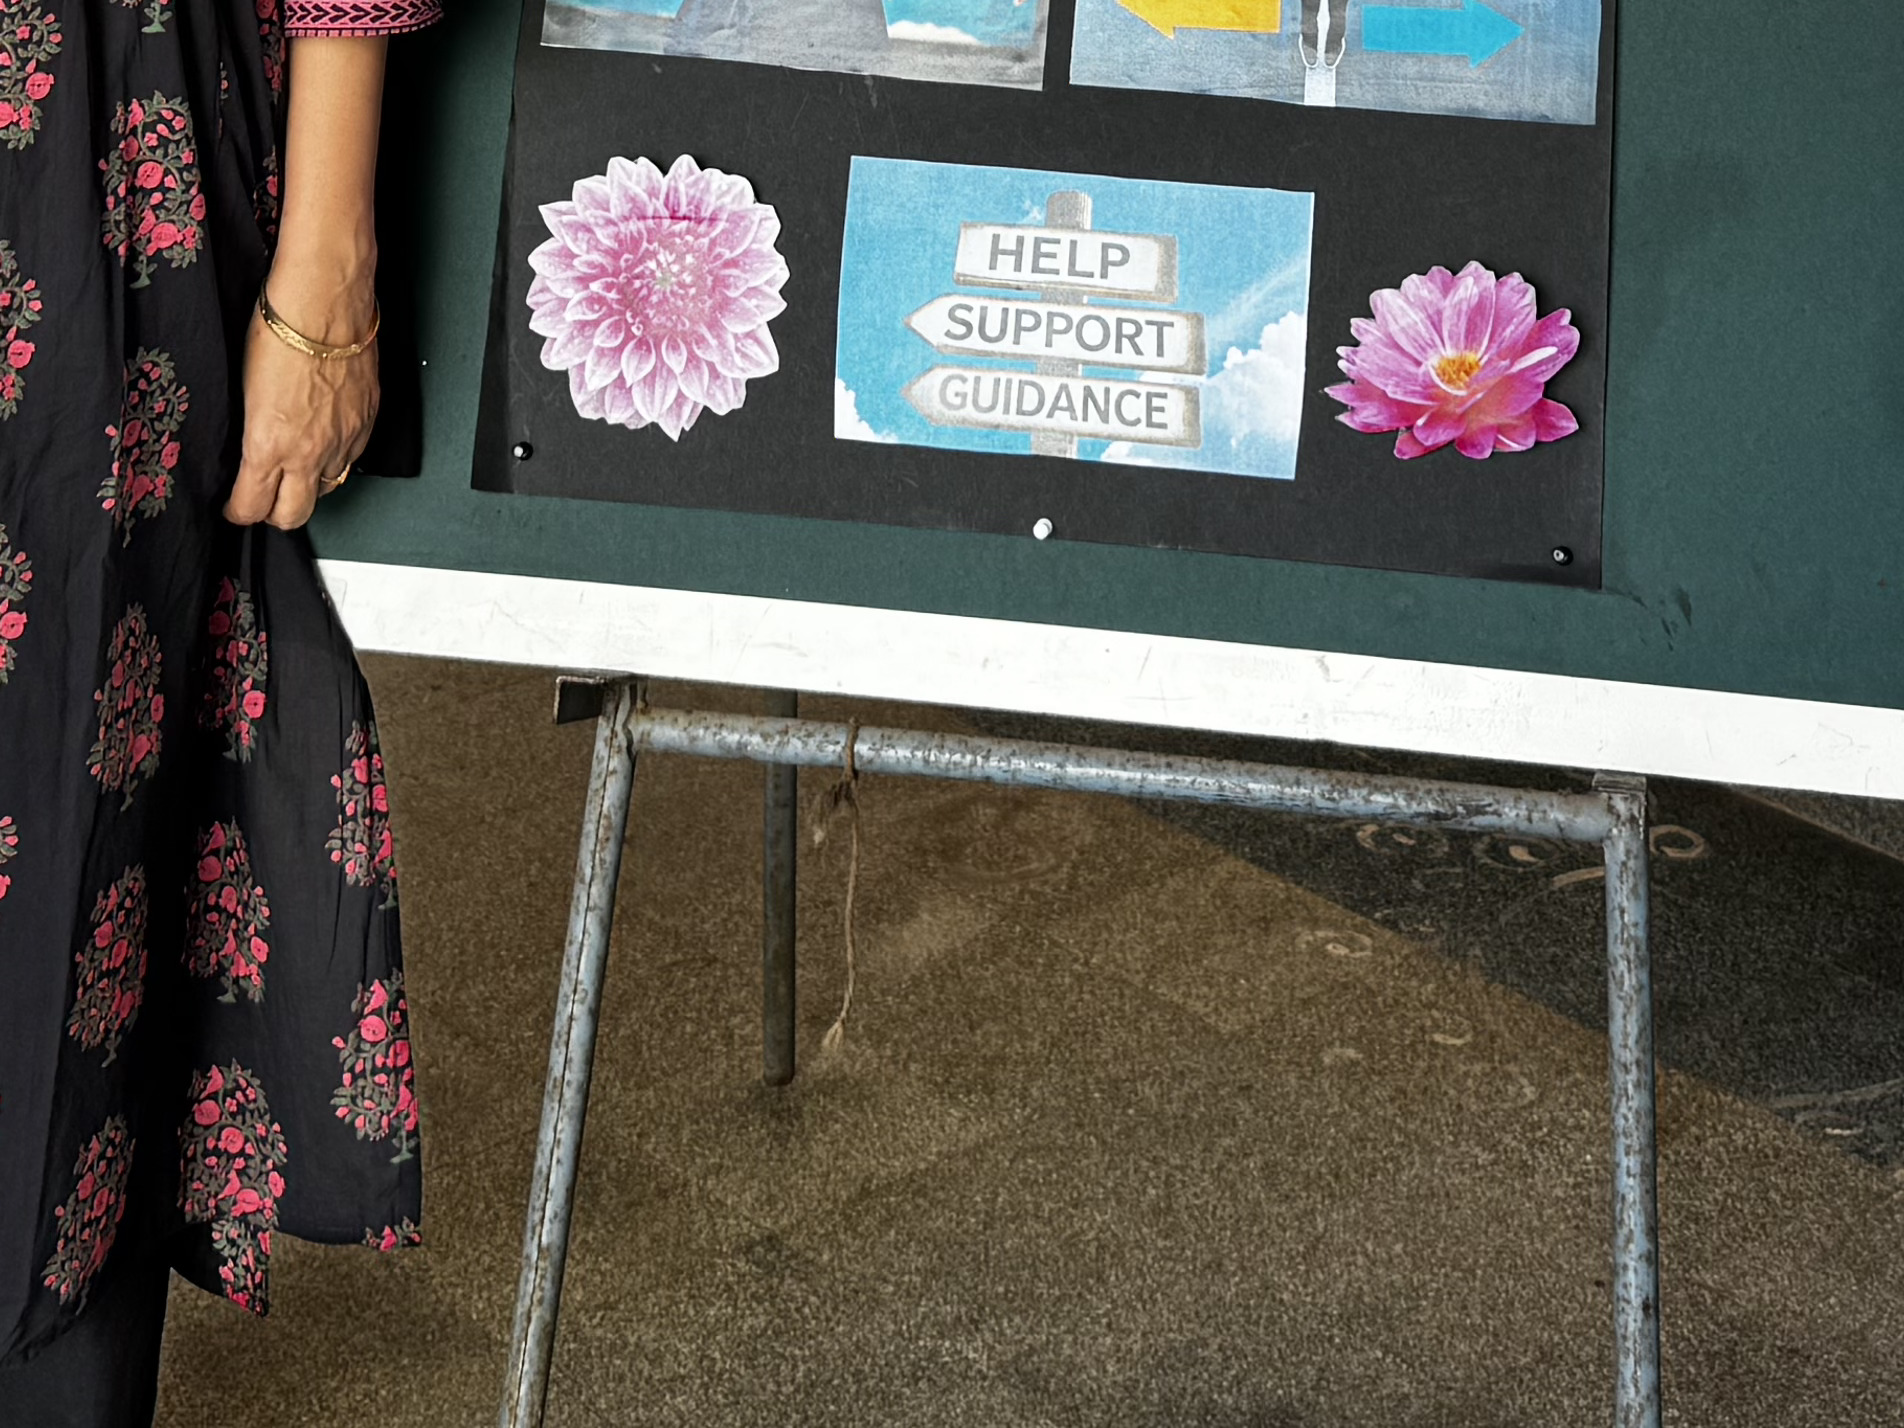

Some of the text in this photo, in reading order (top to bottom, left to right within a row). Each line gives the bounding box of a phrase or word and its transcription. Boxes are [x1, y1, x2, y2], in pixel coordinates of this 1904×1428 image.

[988, 232, 1131, 280] HELP
[943, 302, 1175, 358] SUPPORT
[938, 373, 1169, 430] GUIDANCE
